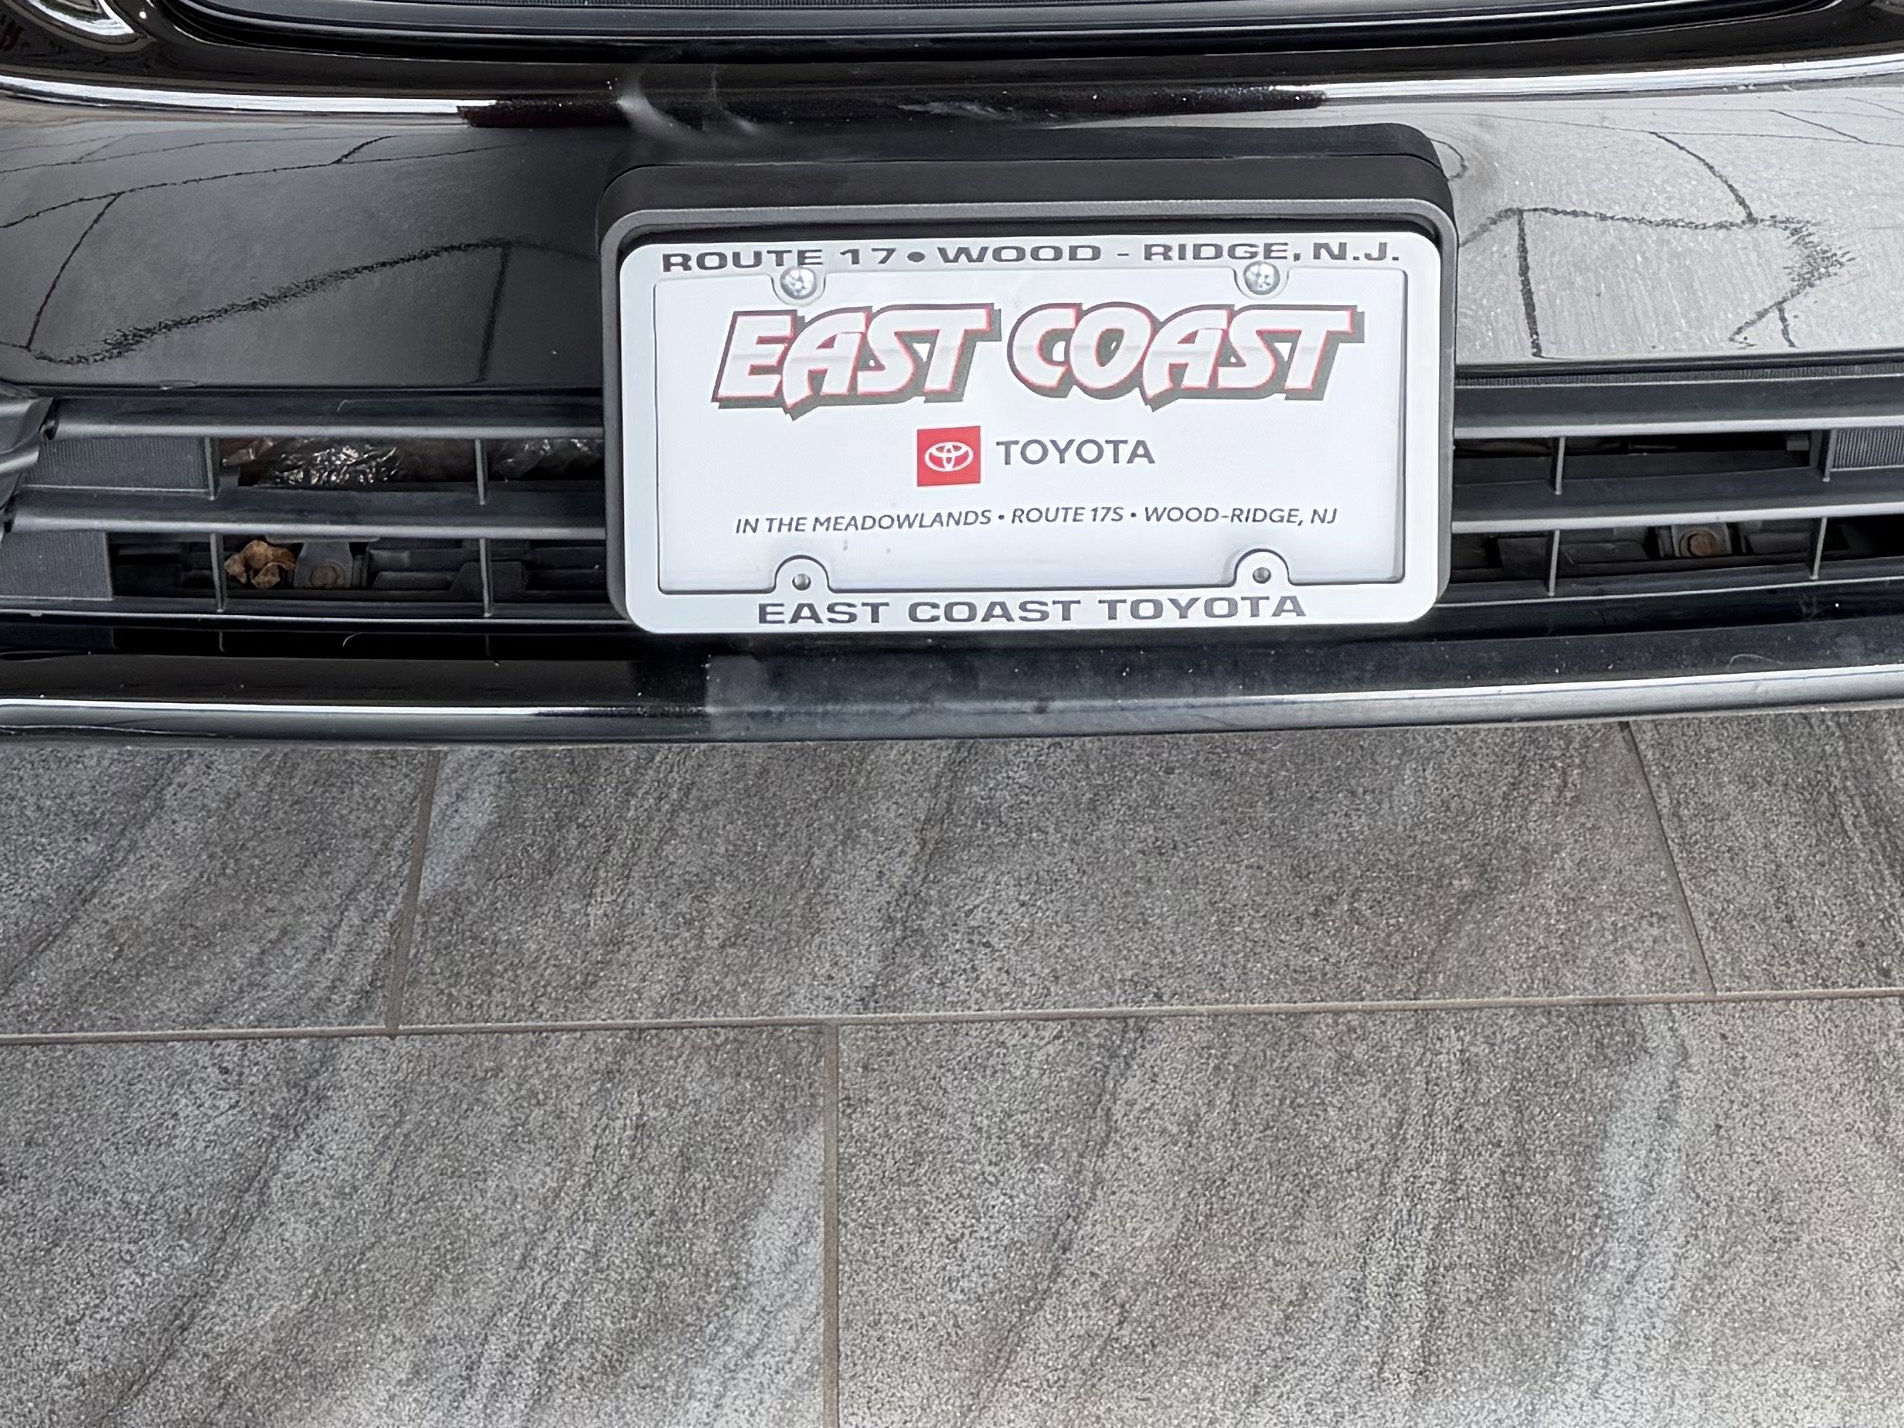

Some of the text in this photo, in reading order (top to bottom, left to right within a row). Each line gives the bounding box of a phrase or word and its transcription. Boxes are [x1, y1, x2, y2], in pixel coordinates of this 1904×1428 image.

[662, 249, 824, 273] ROUTE
[840, 247, 896, 266] 17
[937, 244, 1102, 264] WOOD
[1313, 242, 1400, 261] N.J.
[711, 302, 1365, 422] EAST COAST
[996, 439, 1155, 465] TOYOTA
[736, 507, 1337, 534] IN THE MEADOWLANDS ROUTE 17S WOOD-RIDGE, NJ
[758, 595, 1306, 624] EAST COAST TOYOTA
